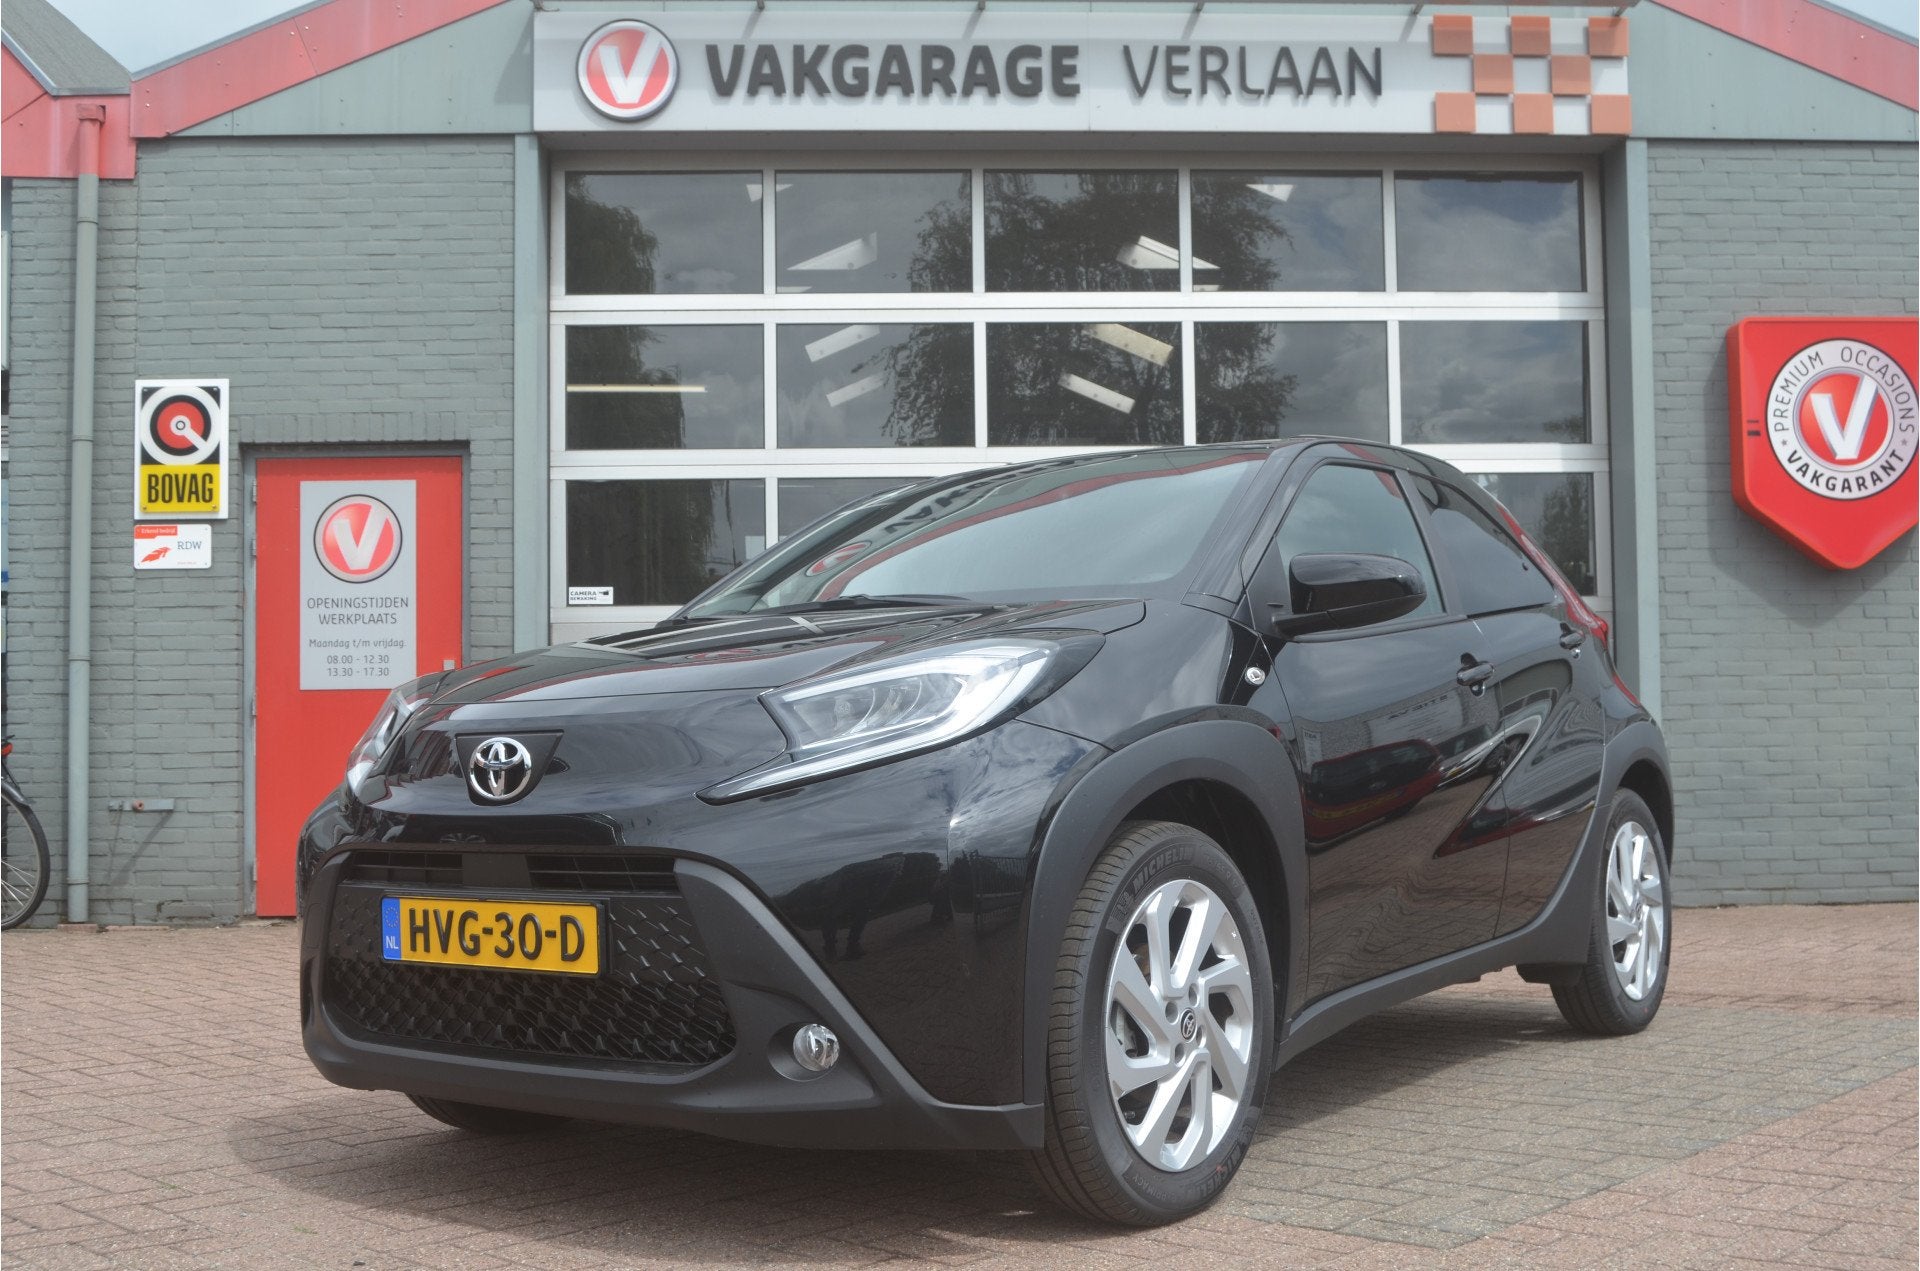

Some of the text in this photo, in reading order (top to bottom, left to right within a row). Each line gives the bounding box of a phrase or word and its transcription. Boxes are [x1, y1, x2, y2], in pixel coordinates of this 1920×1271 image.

[705, 44, 1383, 98] VAKGARAGE VERLAAN
[1774, 346, 1915, 434] PREMIUM OCCASIONS
[1787, 449, 1905, 493] VAKGARANT
[148, 473, 213, 503] BOVAG
[177, 540, 202, 550] RDW
[307, 597, 409, 609] OPENINGSTIJDEN
[319, 613, 397, 625] WERKPLAATS
[309, 638, 350, 650] Maandag
[352, 638, 371, 648] t/m
[326, 655, 353, 665] 08.00
[363, 655, 390, 664] 12.30
[326, 667, 353, 677] 13.30
[363, 667, 390, 677] 17.30
[1133, 846, 1197, 893] MICHELIN
[385, 935, 399, 950] NL
[408, 908, 585, 962] HVG-30-D
